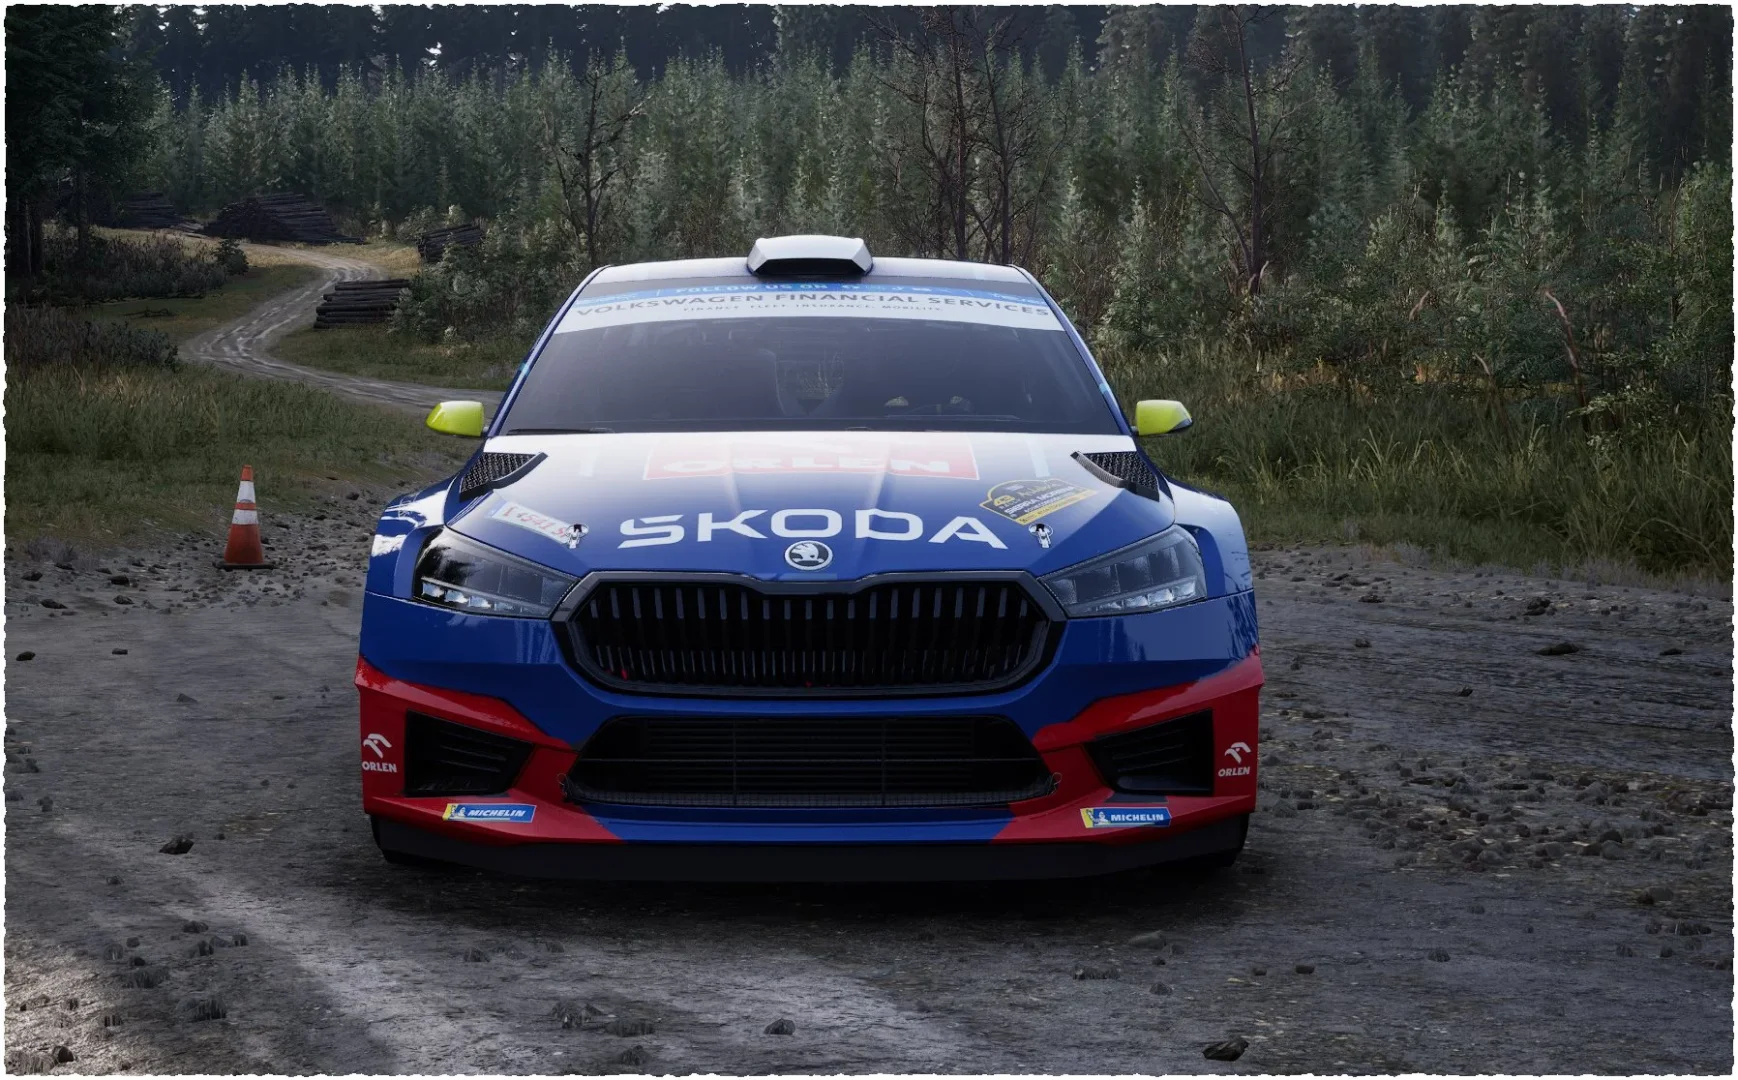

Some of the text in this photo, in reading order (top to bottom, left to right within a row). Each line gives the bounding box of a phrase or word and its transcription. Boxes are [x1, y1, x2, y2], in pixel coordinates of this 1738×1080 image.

[675, 284, 758, 293] FOLLOW
[577, 294, 764, 316] VOLKSWAGEN
[775, 293, 920, 303] FINANCIAL
[927, 297, 1050, 316] SERVICES
[662, 456, 950, 473] ORLEN
[362, 760, 398, 773] ORLEN
[1217, 766, 1251, 777] ORLEN
[467, 809, 526, 817] MICHELIN
[1110, 813, 1165, 822] MICHELIN
